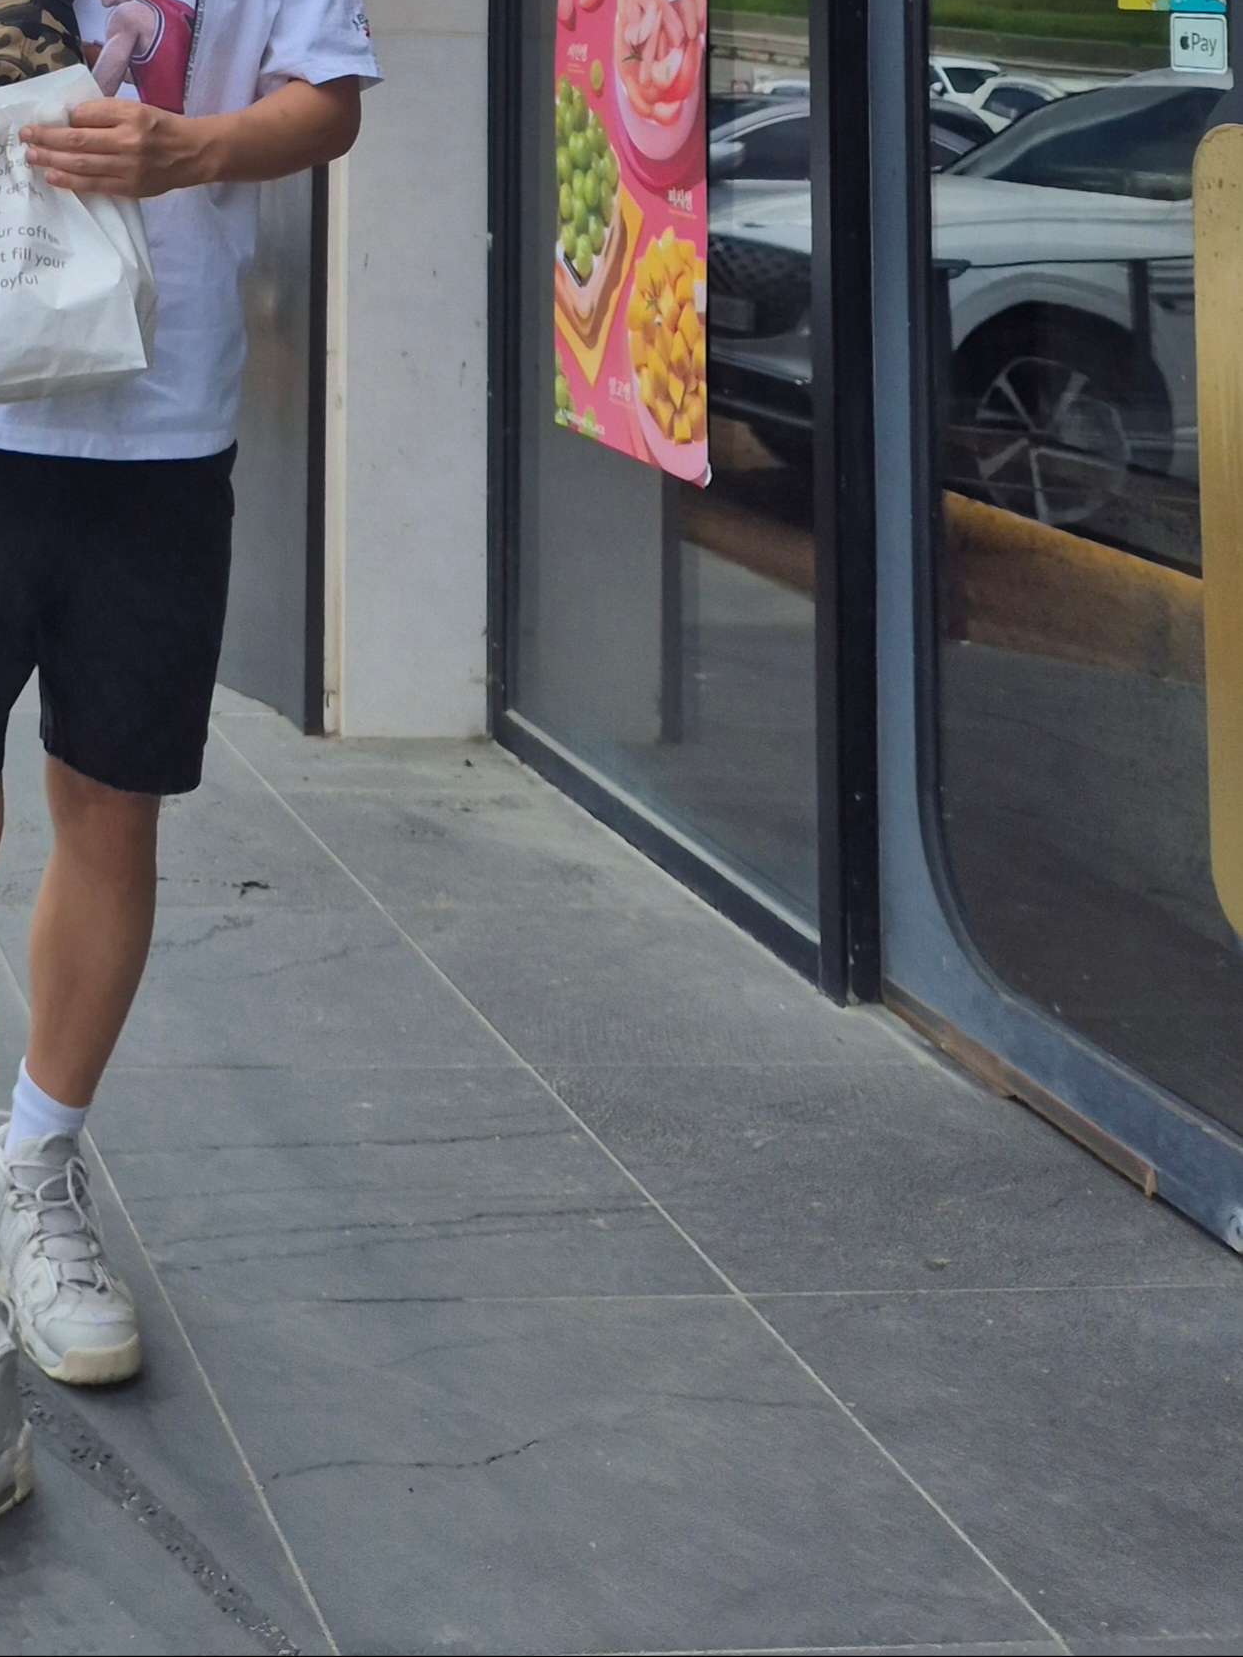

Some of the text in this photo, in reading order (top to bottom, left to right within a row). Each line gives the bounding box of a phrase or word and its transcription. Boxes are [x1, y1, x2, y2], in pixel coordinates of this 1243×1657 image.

[1191, 32, 1217, 57] Pay
[12, 247, 32, 262] fill
[35, 253, 67, 269] your
